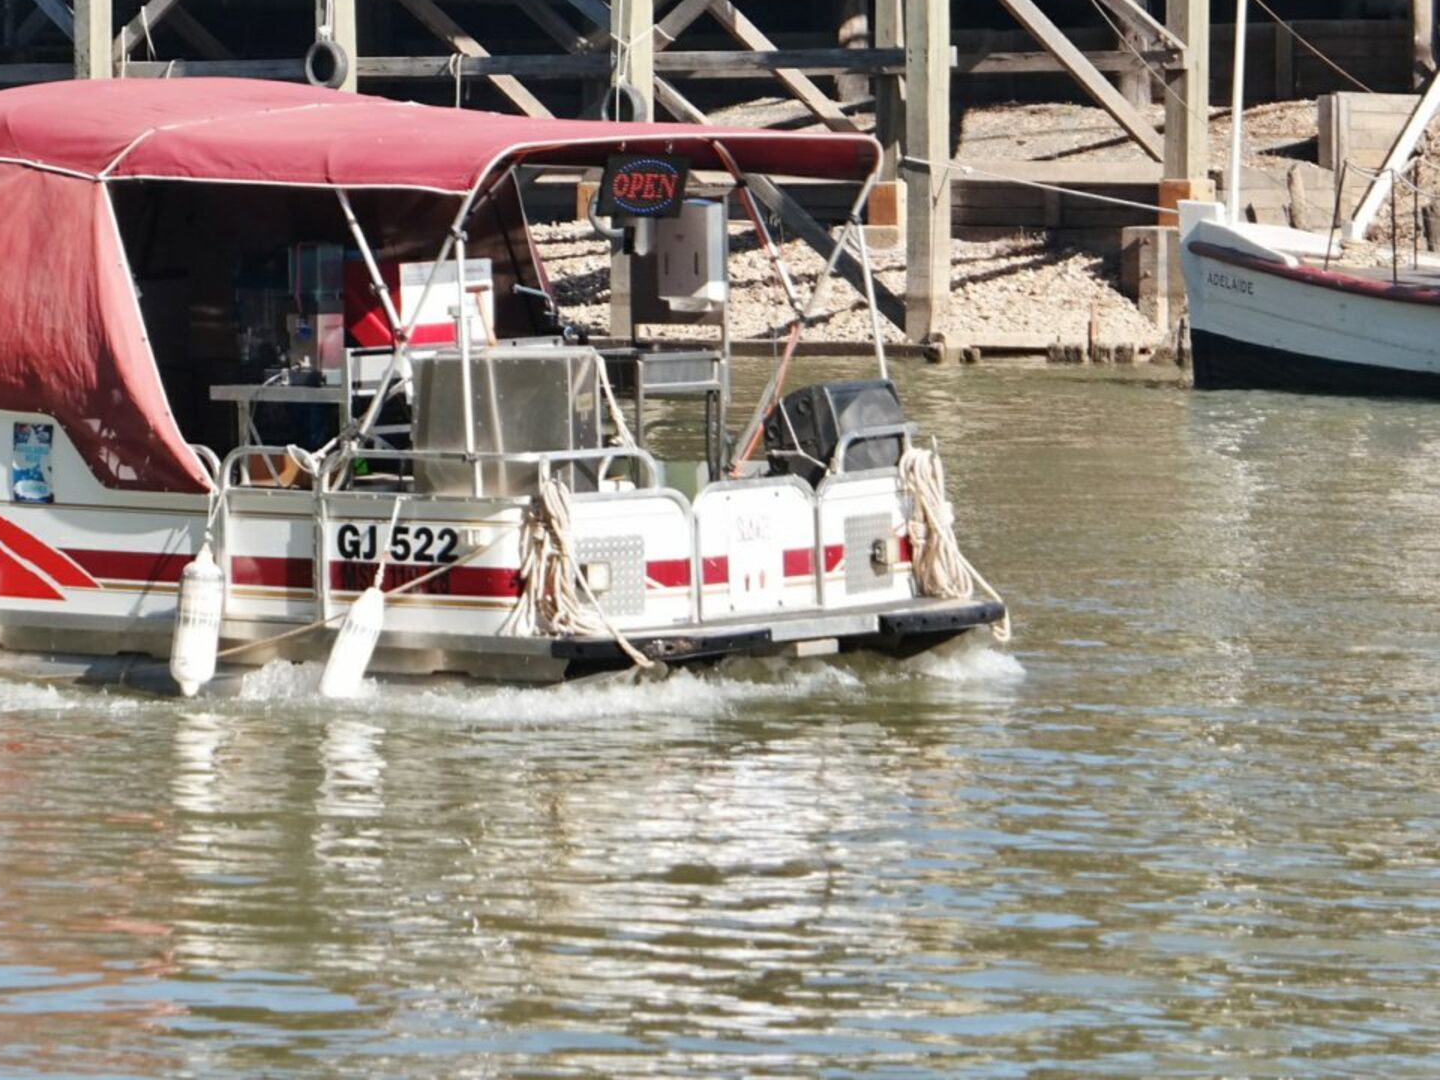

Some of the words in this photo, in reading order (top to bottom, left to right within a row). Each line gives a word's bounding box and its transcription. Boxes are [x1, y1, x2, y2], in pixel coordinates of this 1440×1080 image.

[613, 173, 678, 200] OPEN
[1207, 272, 1254, 295] ADELAIDE
[337, 523, 377, 561] GJ
[390, 526, 460, 563] 522
